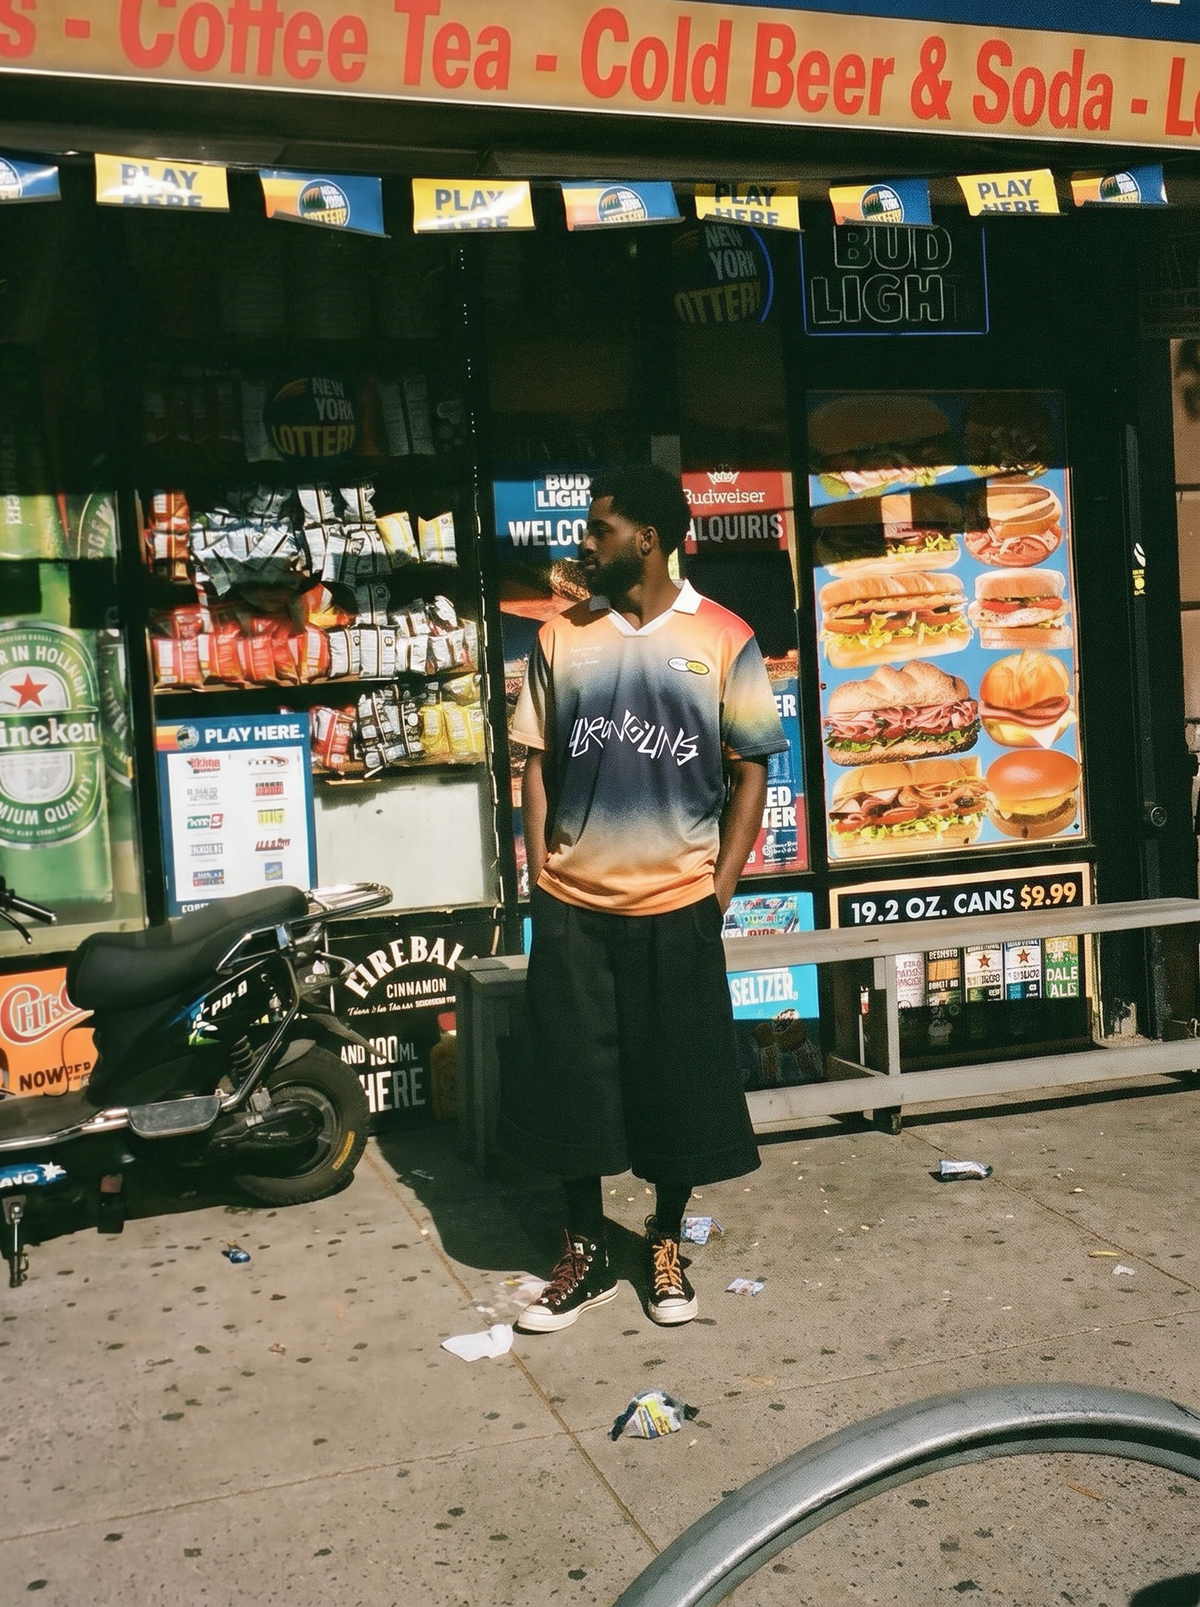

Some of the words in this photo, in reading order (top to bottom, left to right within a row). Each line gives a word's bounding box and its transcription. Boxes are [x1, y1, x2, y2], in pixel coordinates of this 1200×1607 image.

[120, 0, 368, 84] Coffee
[395, 0, 512, 90] Tea
[580, 8, 734, 105] Cold
[750, 22, 895, 116] Beer
[911, 36, 953, 121] &
[973, 40, 1113, 131] Soda
[1165, 57, 1200, 136] L
[435, 188, 505, 211] PLAY
[714, 183, 777, 207] PLAY
[977, 178, 1033, 200] PLAY
[833, 226, 952, 270] BUD
[811, 273, 962, 324] LIGH
[312, 377, 344, 398] NEW
[545, 474, 592, 491] BUD
[11, 645, 29, 662] IN
[204, 727, 252, 744] PLAY
[254, 724, 305, 741] HERE.
[852, 900, 899, 924] 19.2
[905, 896, 948, 919] OZ.
[953, 888, 1015, 914] CANS
[386, 978, 447, 999] CINNAMON
[340, 1044, 366, 1065] AND
[19, 1065, 67, 1092] NOW
